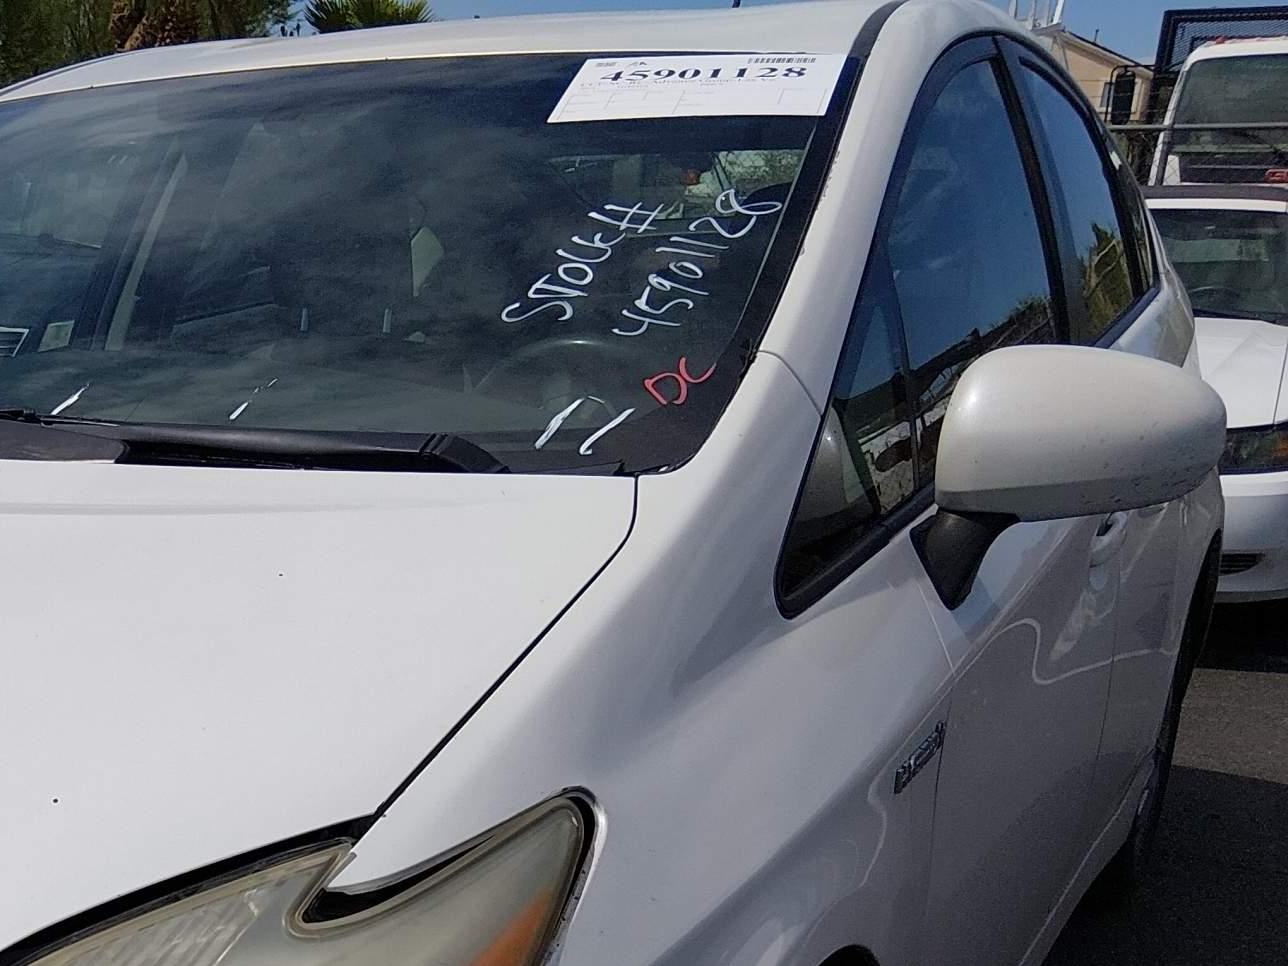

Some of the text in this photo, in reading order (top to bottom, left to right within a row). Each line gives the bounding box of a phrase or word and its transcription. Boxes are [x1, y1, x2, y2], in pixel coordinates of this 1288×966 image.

[600, 66, 808, 82] 45901128
[611, 188, 783, 337] 45901128
[643, 356, 717, 406] DC
